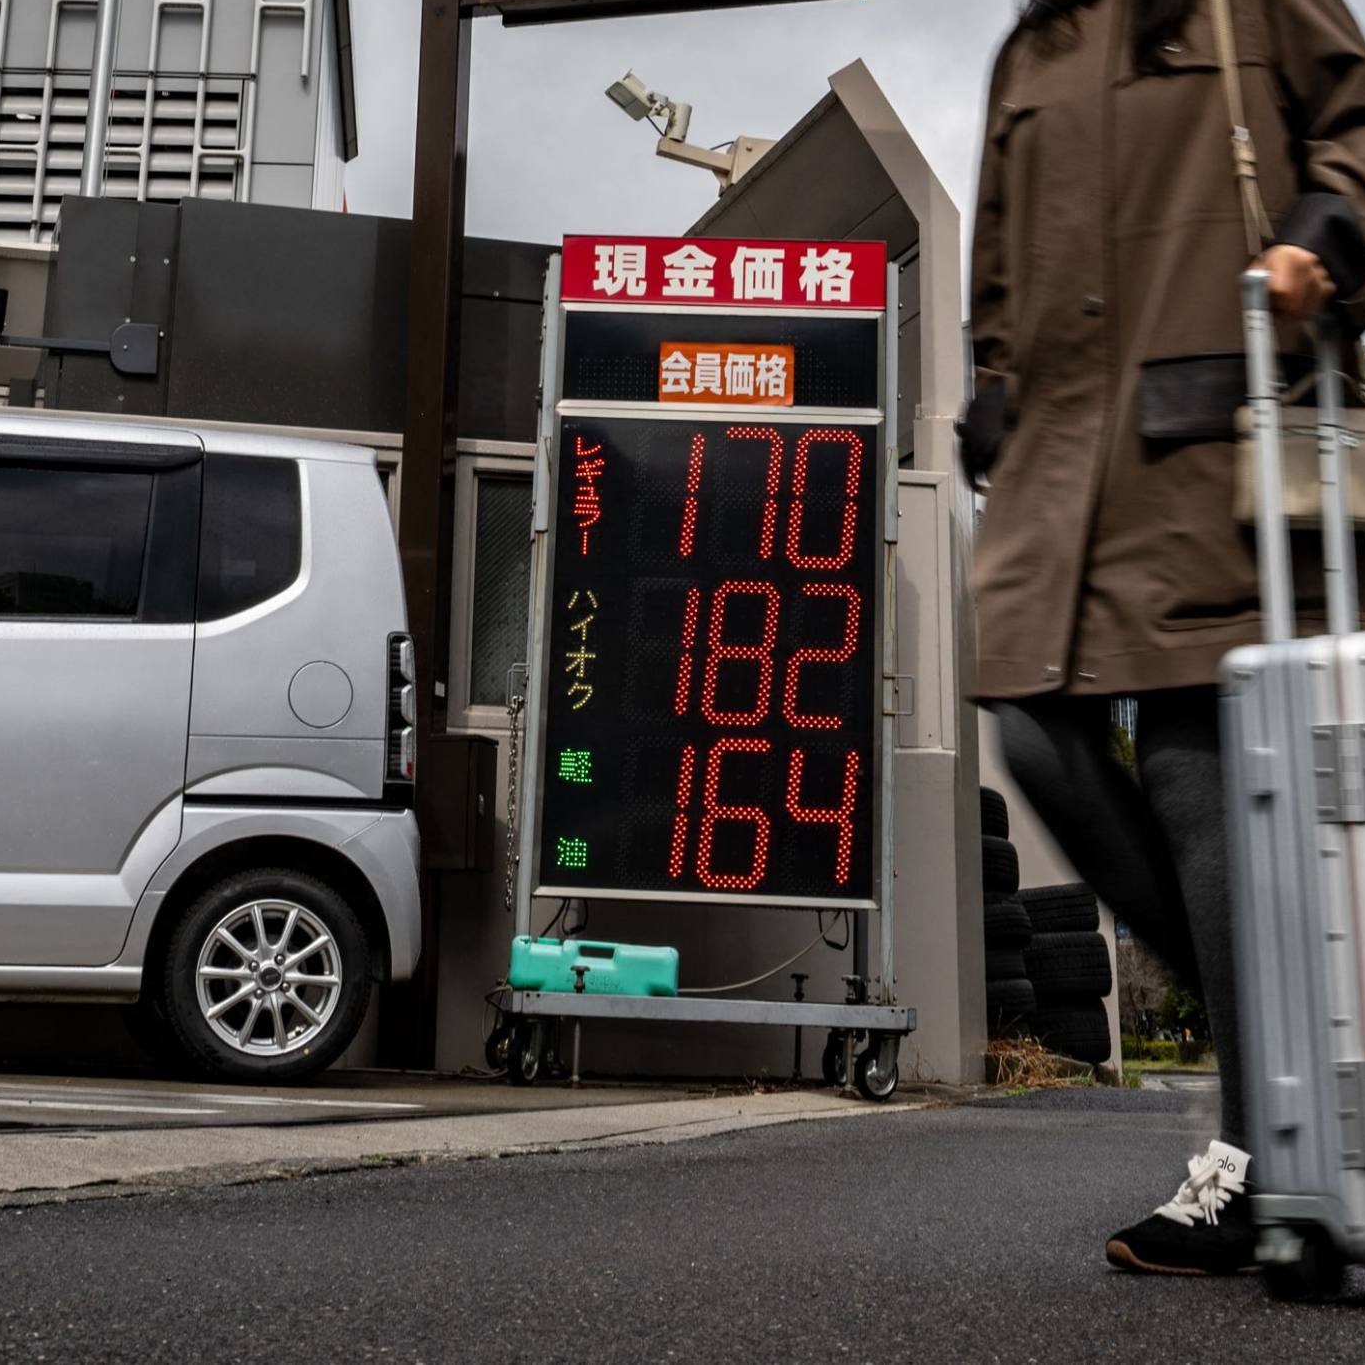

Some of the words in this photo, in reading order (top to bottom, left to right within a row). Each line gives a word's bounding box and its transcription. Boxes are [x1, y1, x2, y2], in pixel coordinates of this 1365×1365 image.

[592, 244, 854, 302] 現金価格
[661, 351, 787, 398] 会員価格
[573, 435, 606, 556] レギュラー
[679, 426, 864, 570] 170
[564, 589, 599, 711] ハイオク
[674, 580, 862, 730] 182
[557, 746, 593, 868] 軽油
[668, 737, 861, 890] 164
